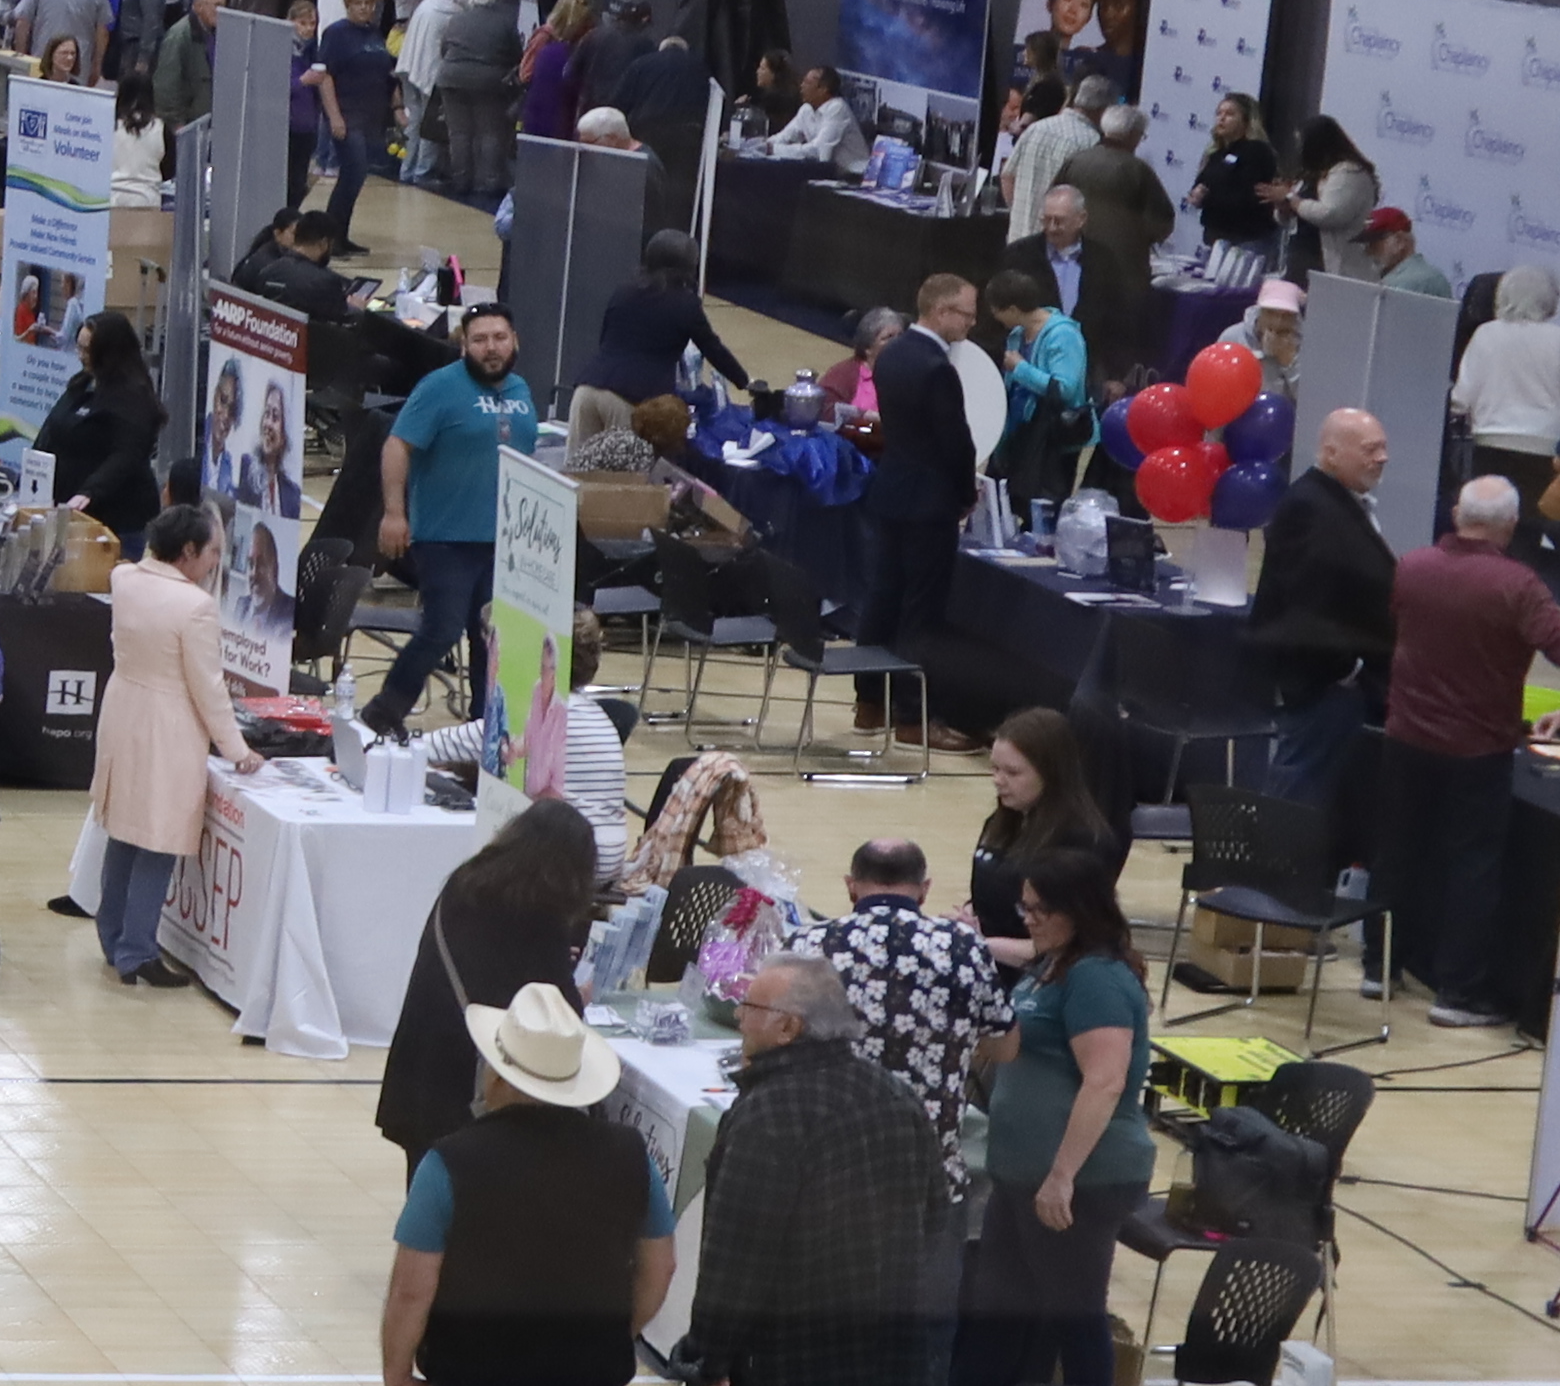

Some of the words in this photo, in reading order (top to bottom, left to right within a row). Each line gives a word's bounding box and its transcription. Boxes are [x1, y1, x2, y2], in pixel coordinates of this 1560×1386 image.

[53, 140, 101, 162] Volunteer
[212, 298, 246, 326] AARP
[245, 309, 298, 348] Foundation
[516, 496, 562, 563] Solutions
[221, 628, 267, 656] employed
[225, 644, 237, 663] for
[240, 653, 271, 678] Work?
[41, 725, 93, 740] hapo.org
[165, 828, 243, 951] CSEP
